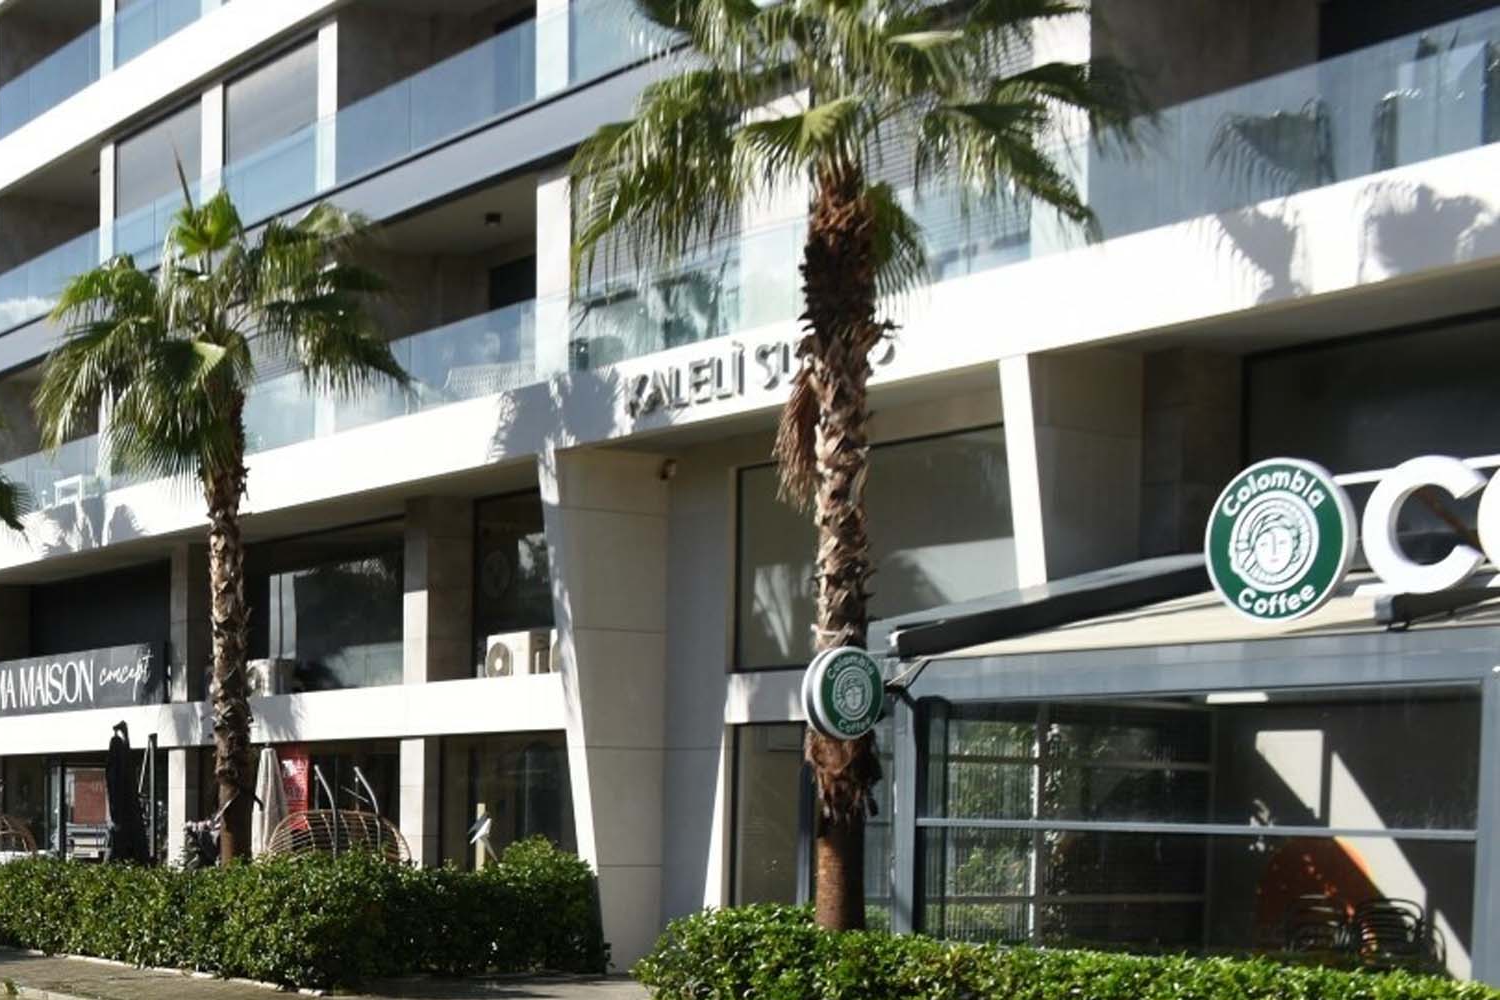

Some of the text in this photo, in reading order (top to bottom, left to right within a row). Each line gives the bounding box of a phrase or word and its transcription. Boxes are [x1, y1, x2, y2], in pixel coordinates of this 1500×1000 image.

[1221, 470, 1326, 517] Colombia
[1238, 583, 1317, 616] Coffee
[19, 659, 94, 708] MAISON
[99, 646, 153, 702] concept
